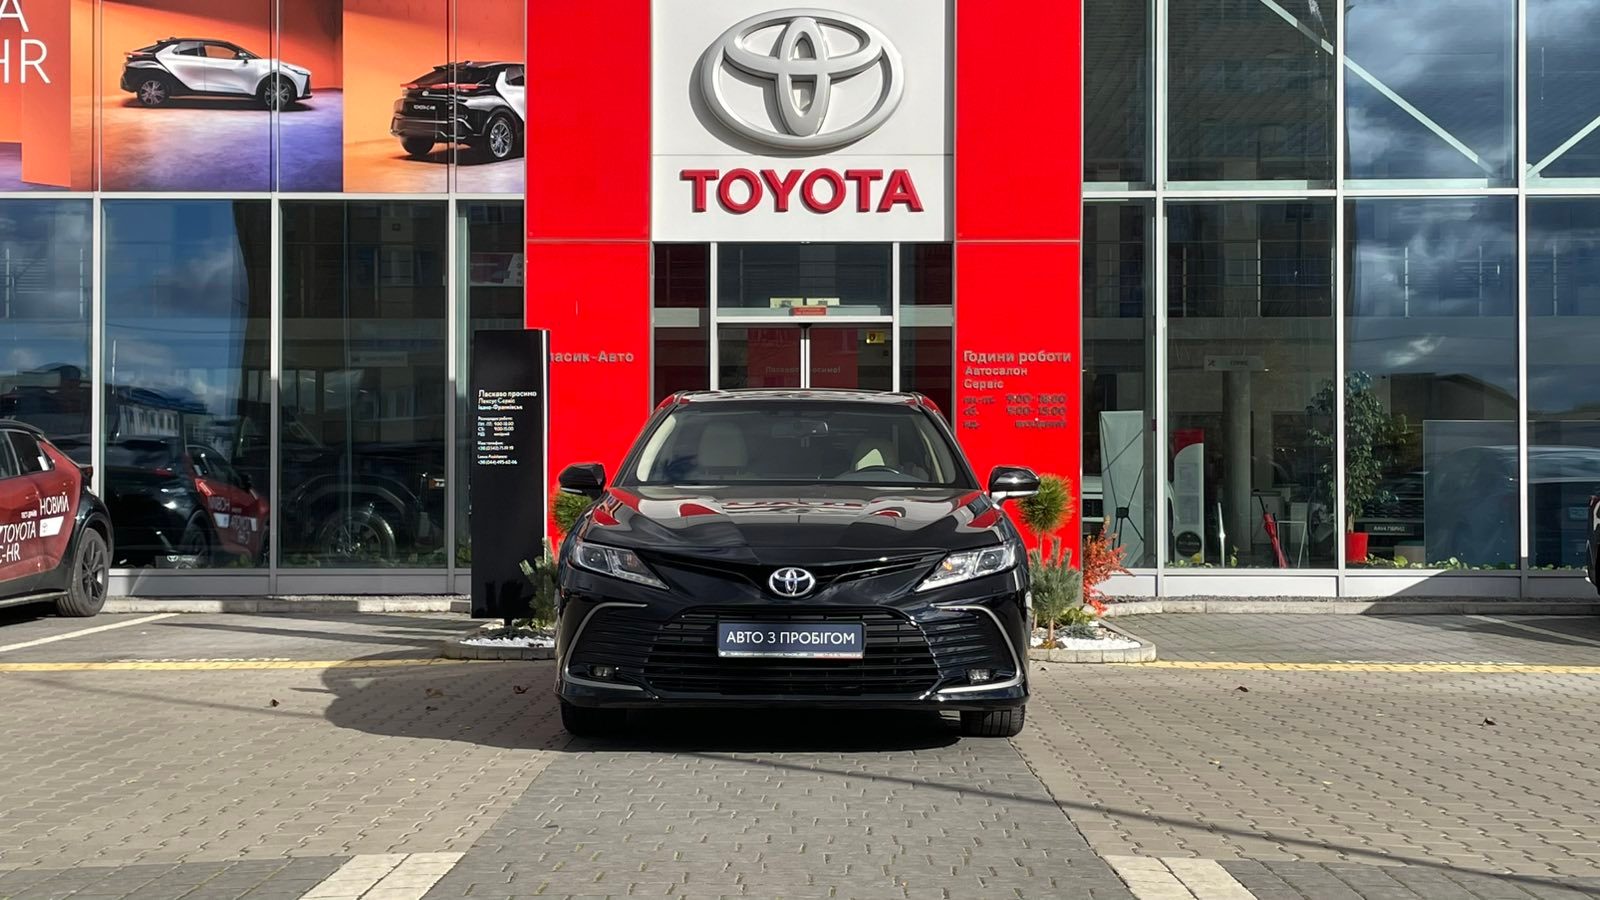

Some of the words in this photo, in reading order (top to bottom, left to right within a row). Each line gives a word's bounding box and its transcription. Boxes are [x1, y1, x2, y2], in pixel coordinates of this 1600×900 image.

[680, 168, 924, 214] TOYOTA
[963, 350, 1014, 363] Години
[1018, 350, 1072, 364] роботи
[965, 366, 1028, 376] Автосалон
[963, 379, 1004, 390] Сервіс
[478, 389, 507, 398] Ласкаво
[508, 391, 538, 399] просимо
[40, 493, 70, 516] НОВИЙ
[3, 521, 37, 543] TOYOTA
[726, 631, 764, 644] АВТО
[767, 631, 776, 644] З
[780, 631, 855, 645] ПРОБІГОМ
